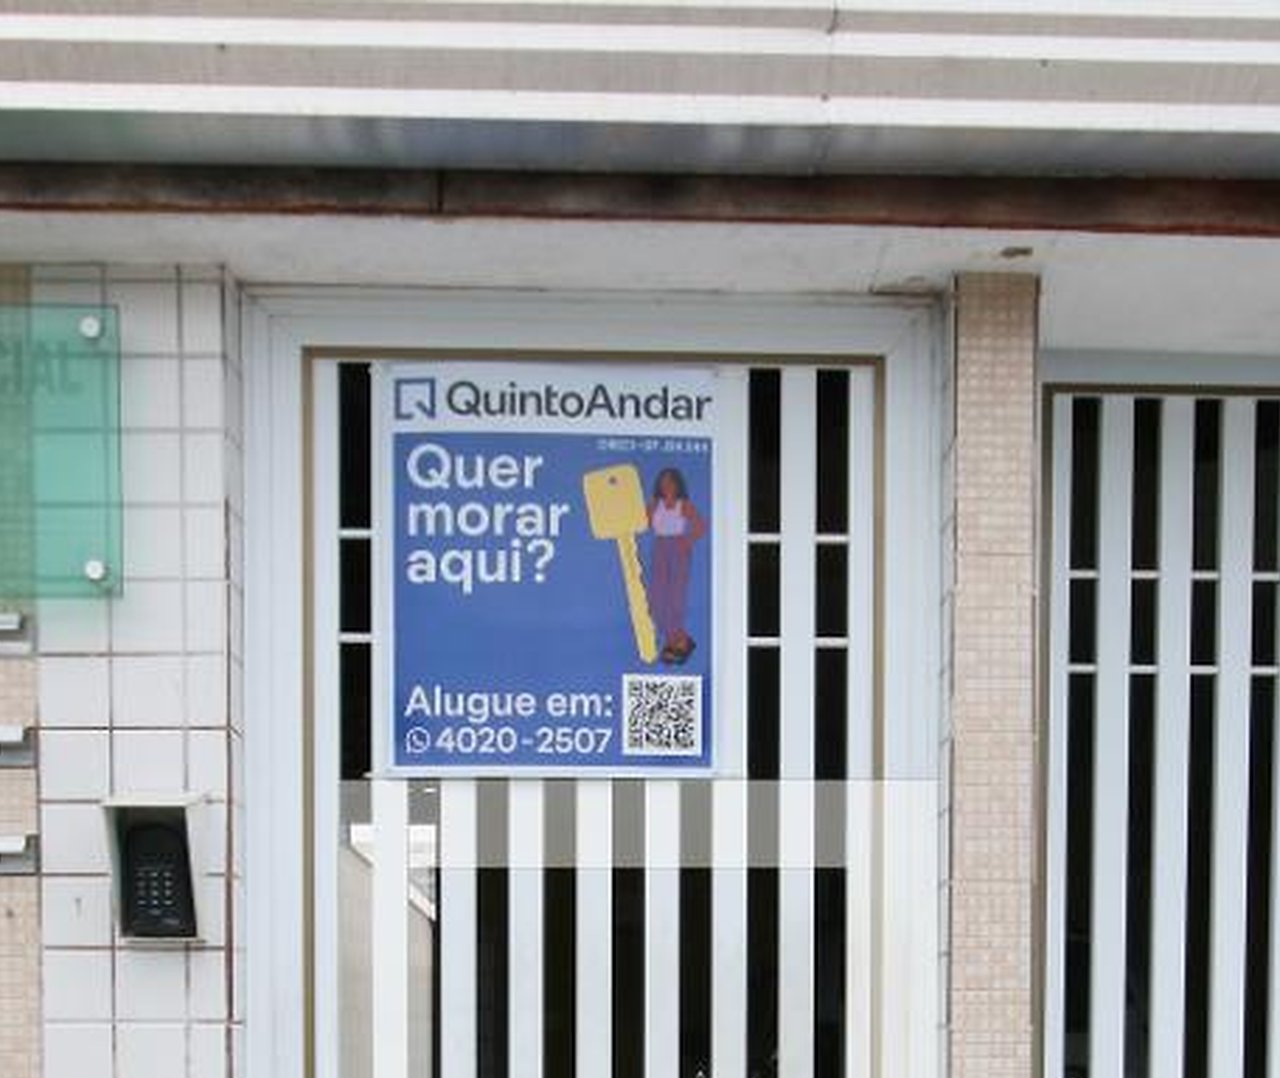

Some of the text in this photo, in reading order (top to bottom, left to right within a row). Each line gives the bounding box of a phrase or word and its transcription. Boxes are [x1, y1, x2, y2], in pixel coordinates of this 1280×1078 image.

[446, 380, 713, 421] QuintoAndar
[407, 443, 543, 489] Quer
[408, 500, 569, 537] morar
[407, 538, 555, 594] aqui?
[405, 685, 613, 723] Alugue em:
[435, 726, 612, 754] 4020-2507
